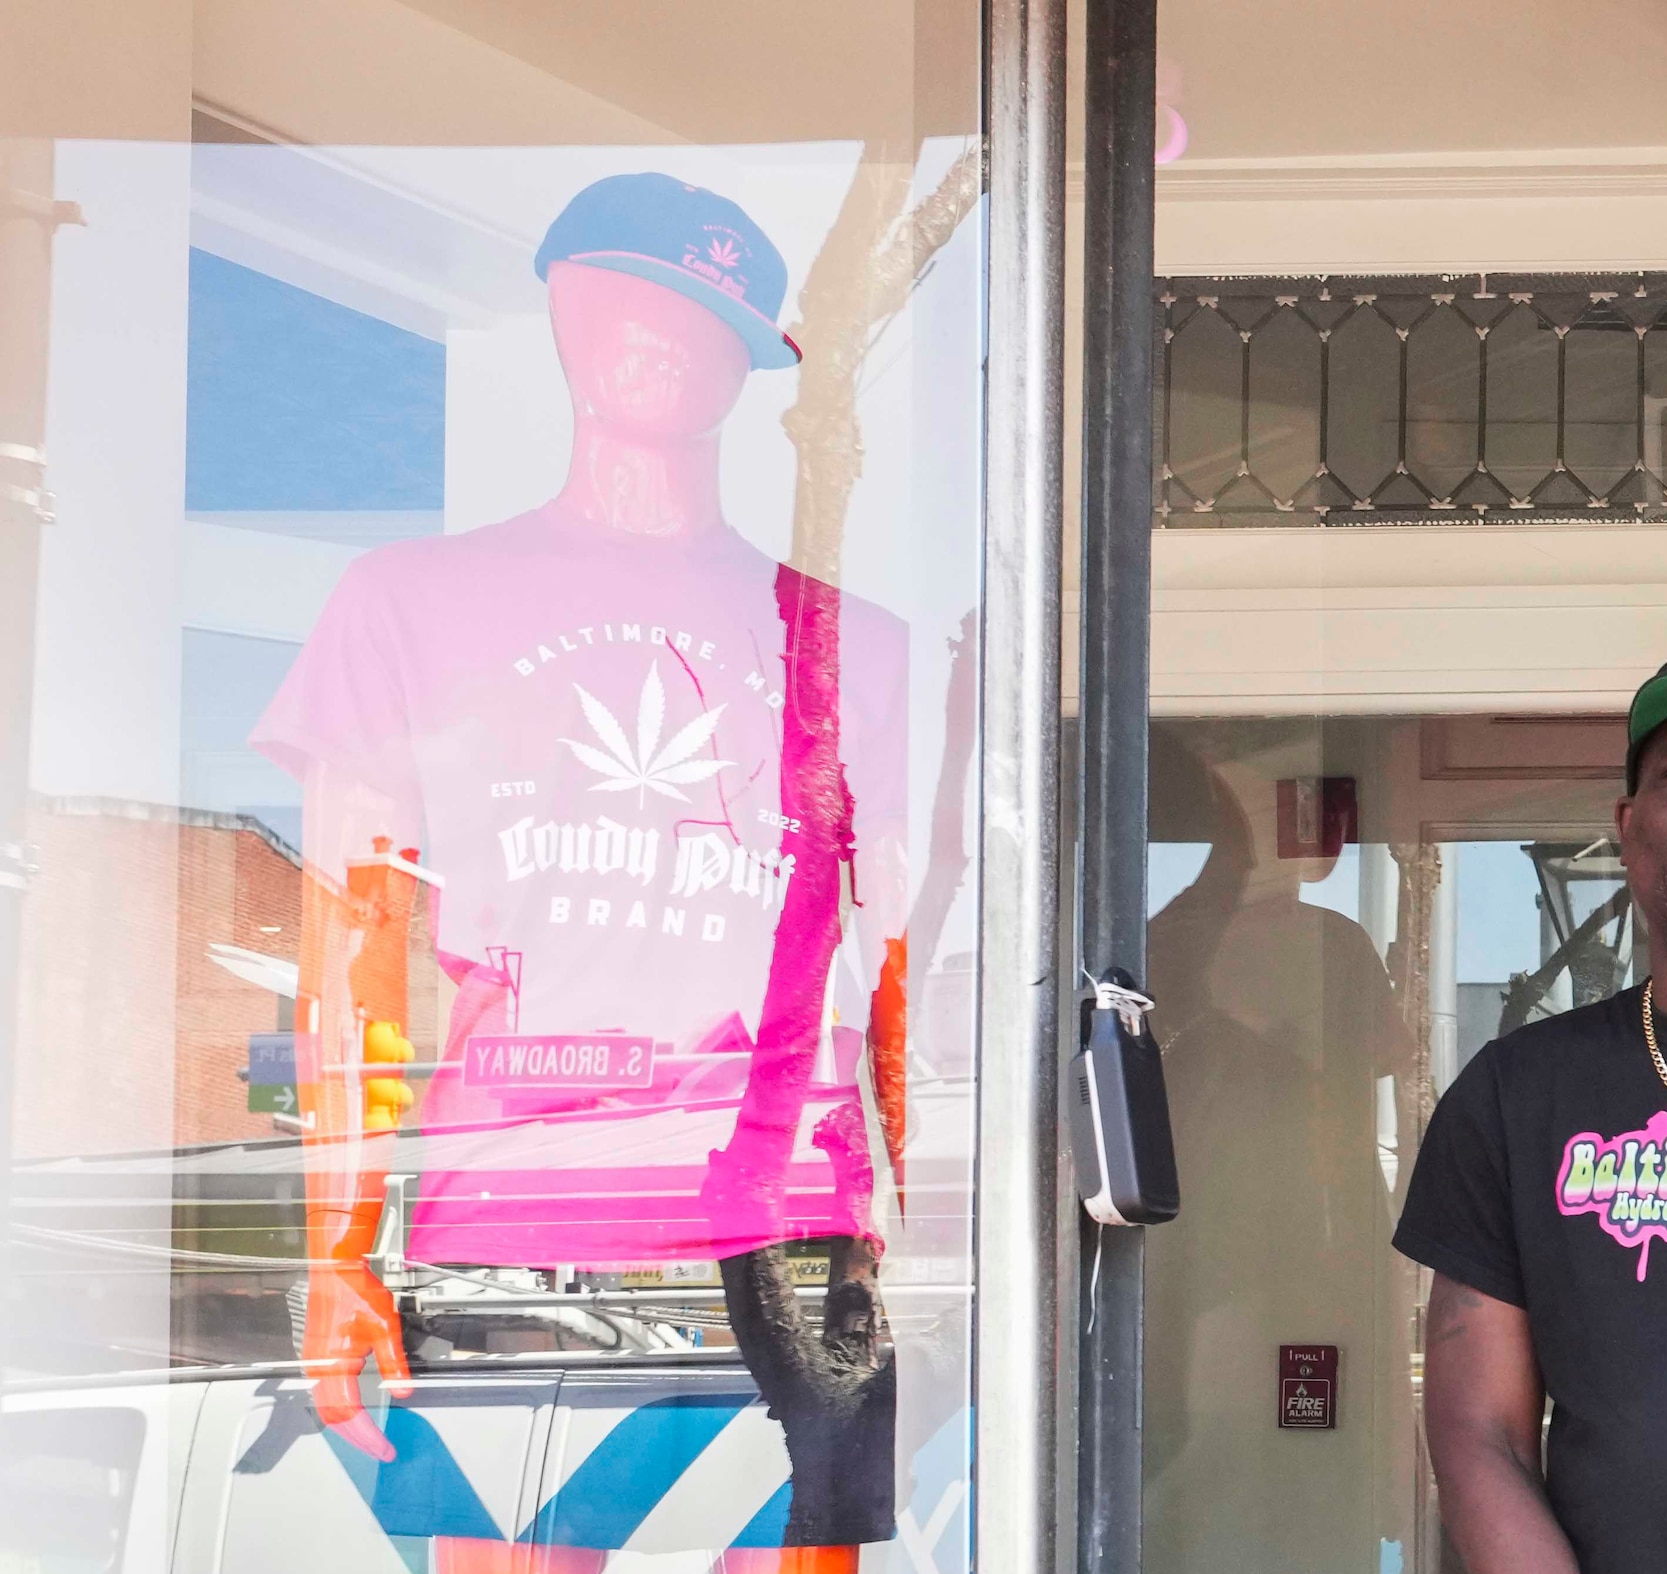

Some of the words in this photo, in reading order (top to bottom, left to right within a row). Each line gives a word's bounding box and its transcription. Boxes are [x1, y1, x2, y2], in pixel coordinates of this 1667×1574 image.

[744, 671, 784, 709] MD
[491, 780, 536, 798] ESTD
[757, 808, 801, 834] 2022
[549, 896, 727, 942] BRAND
[1295, 1353, 1318, 1361] PULL
[1287, 1397, 1326, 1410] FIRE
